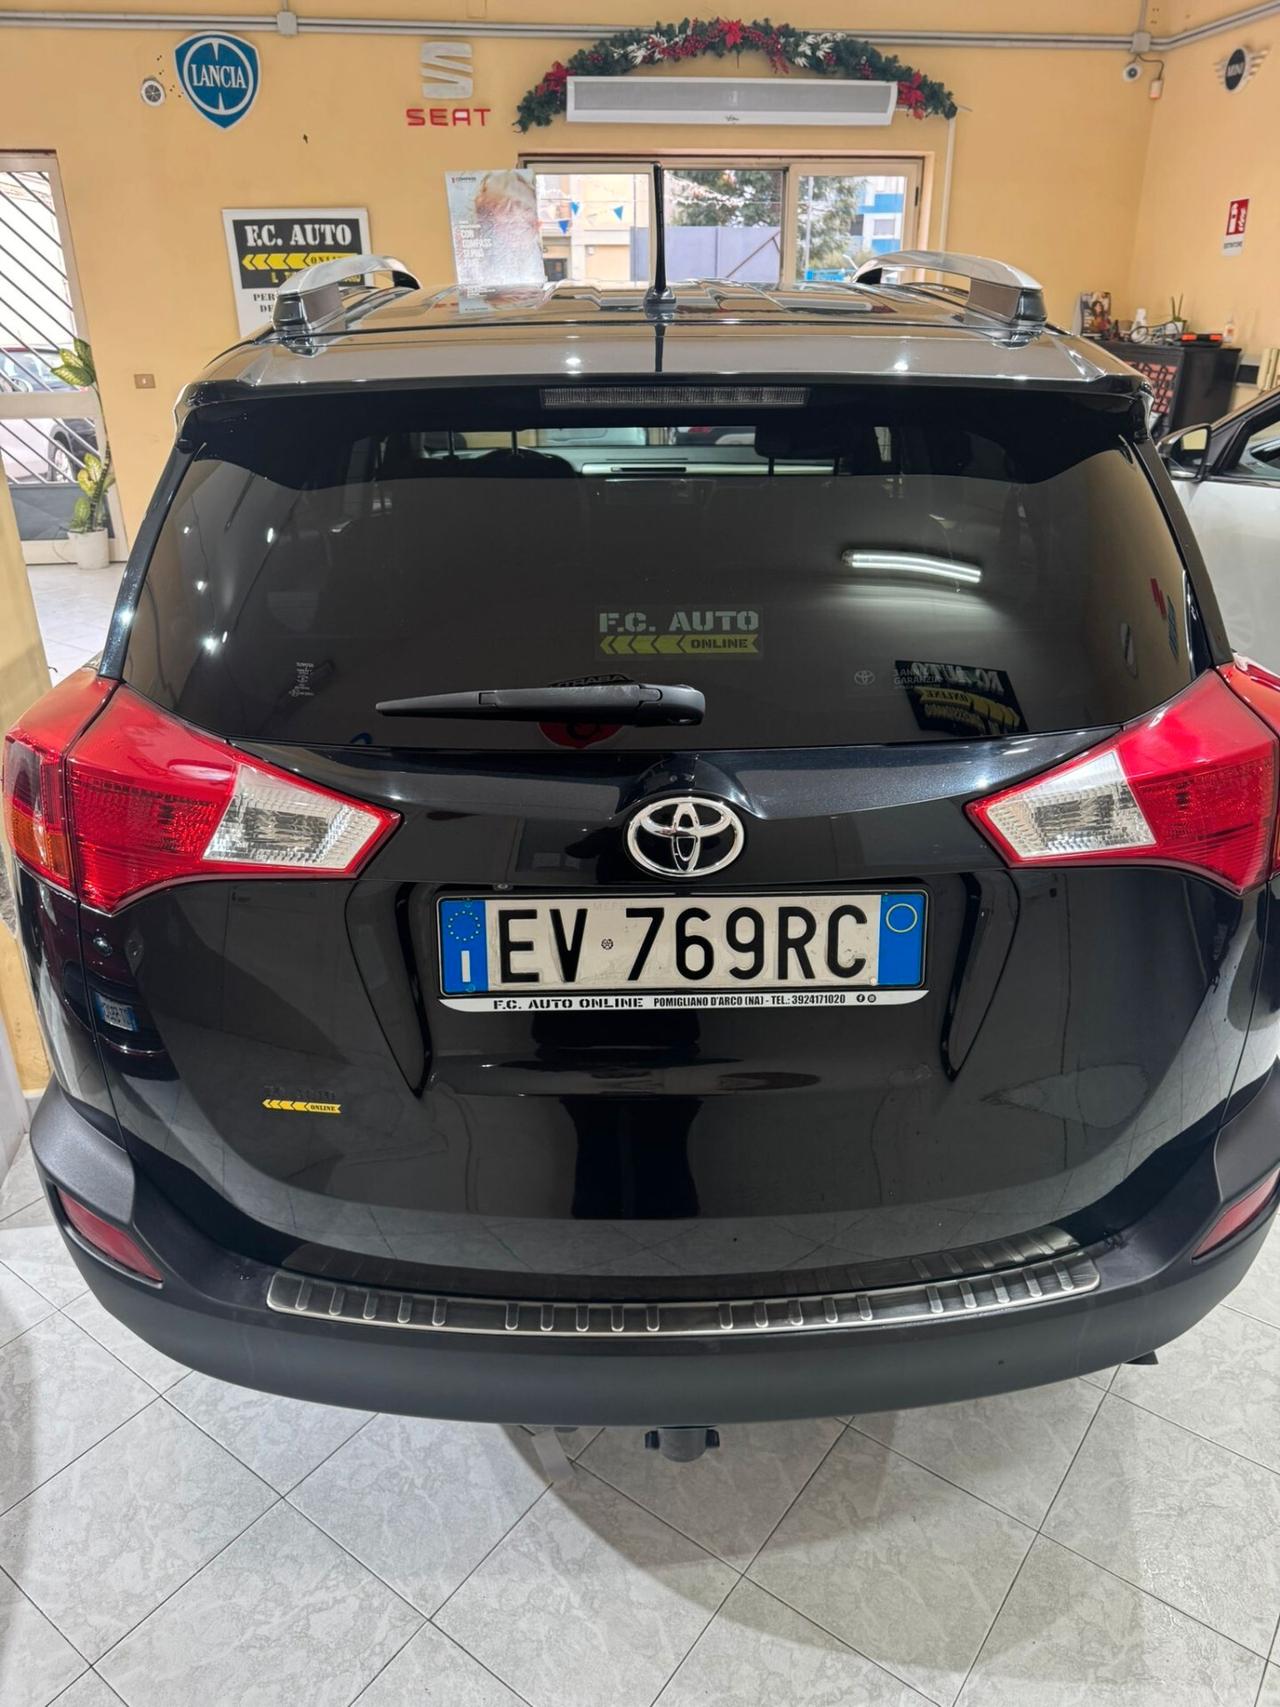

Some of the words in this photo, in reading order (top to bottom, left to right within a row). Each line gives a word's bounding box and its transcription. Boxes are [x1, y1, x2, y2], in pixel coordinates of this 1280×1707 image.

[191, 64, 247, 88] LANCIA
[406, 108, 491, 126] SEAT
[244, 225, 283, 246] F.C.
[290, 224, 353, 246] AUTO
[599, 612, 656, 632] F.C.
[669, 610, 759, 631] AUTO
[691, 638, 748, 649] ONLINE
[498, 907, 588, 984] EV
[625, 904, 867, 982] 769RC
[461, 950, 471, 983] I
[493, 999, 522, 1010] F.C.
[528, 998, 573, 1009] AUTO
[579, 997, 644, 1008] ONLINE
[653, 997, 708, 1007] POMIGLIANO
[711, 996, 743, 1006] D'ARCO
[745, 996, 764, 1006] (NA)
[791, 994, 845, 1004] 3924171020
[310, 1104, 337, 1112] ONLINE
